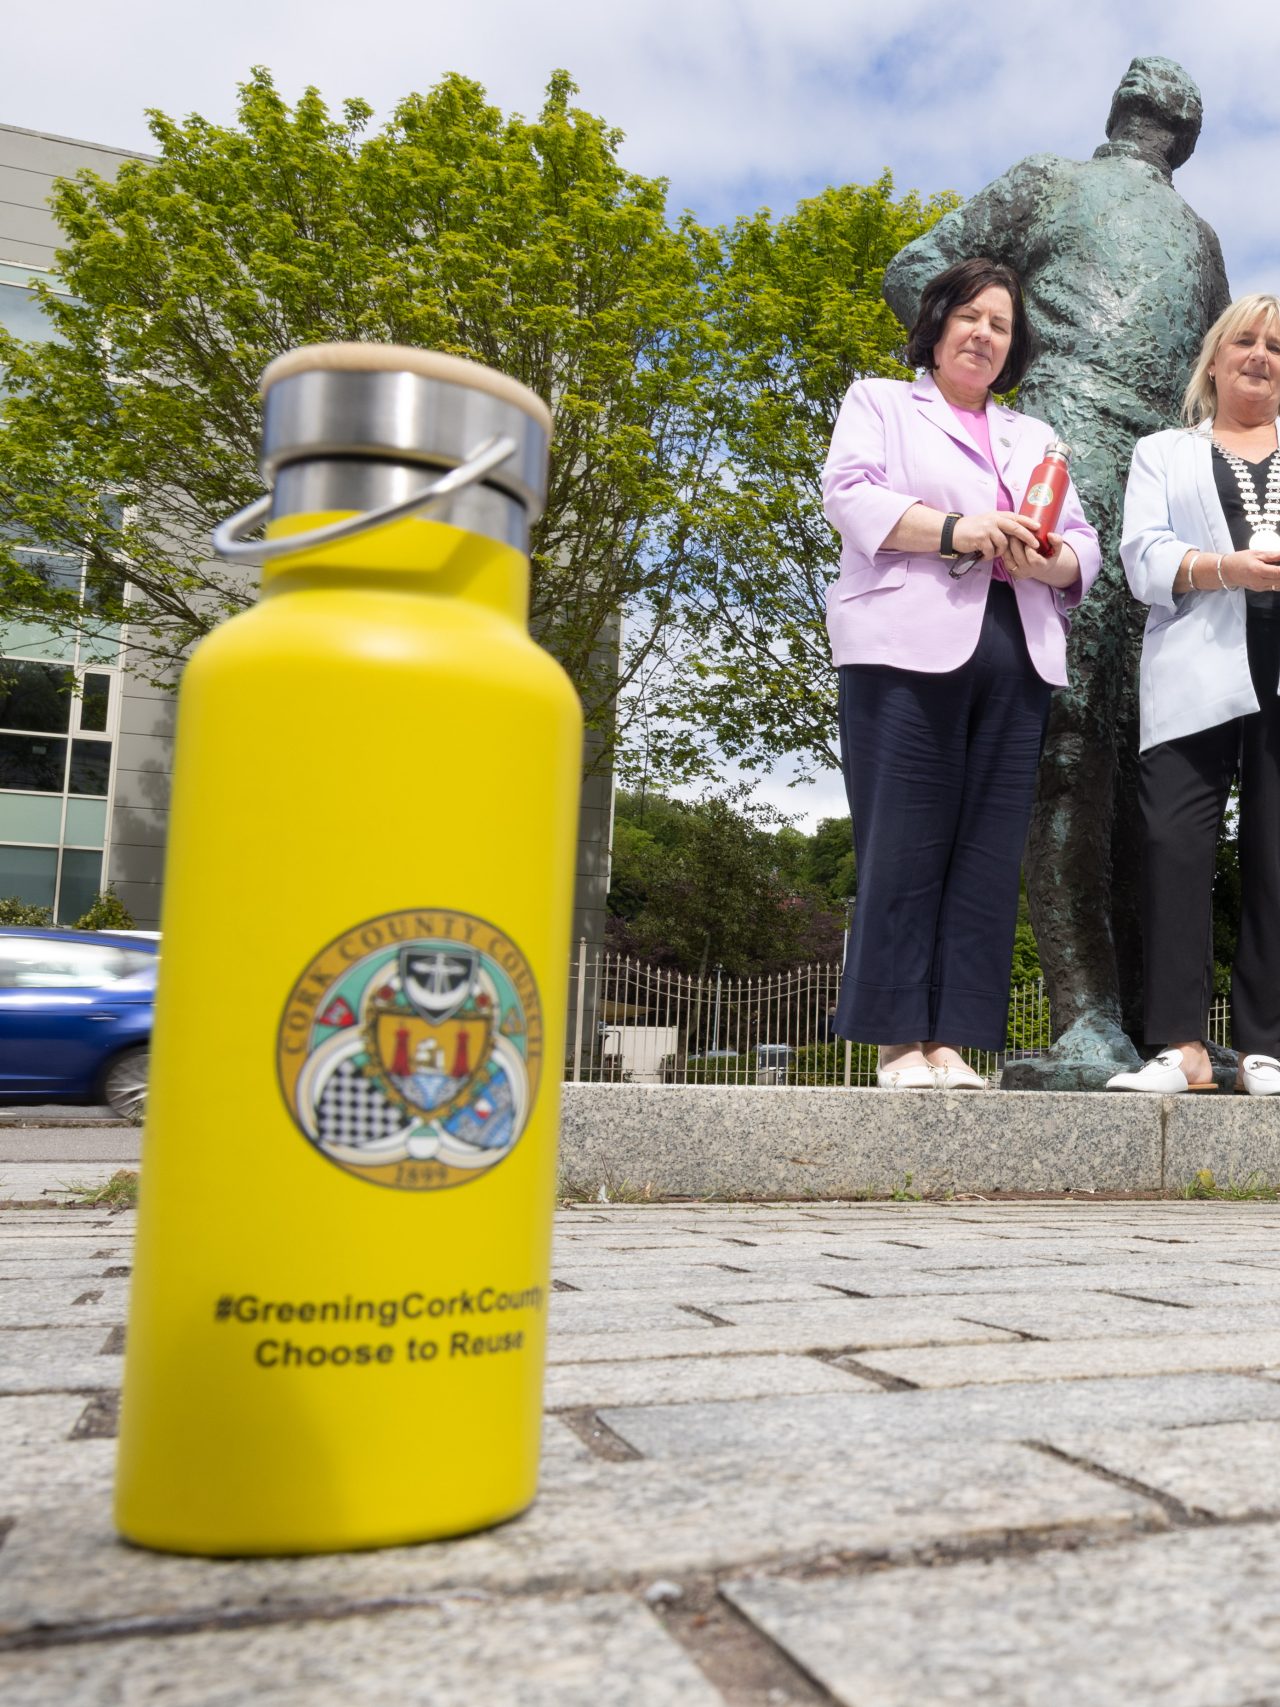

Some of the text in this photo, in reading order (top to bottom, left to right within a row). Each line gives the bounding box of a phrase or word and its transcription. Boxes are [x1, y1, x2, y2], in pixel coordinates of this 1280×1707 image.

[285, 915, 542, 1058] CORK COUNTY COUNCIL
[395, 1164, 448, 1186] 1899
[253, 1329, 524, 1369] Choose to Reuse
